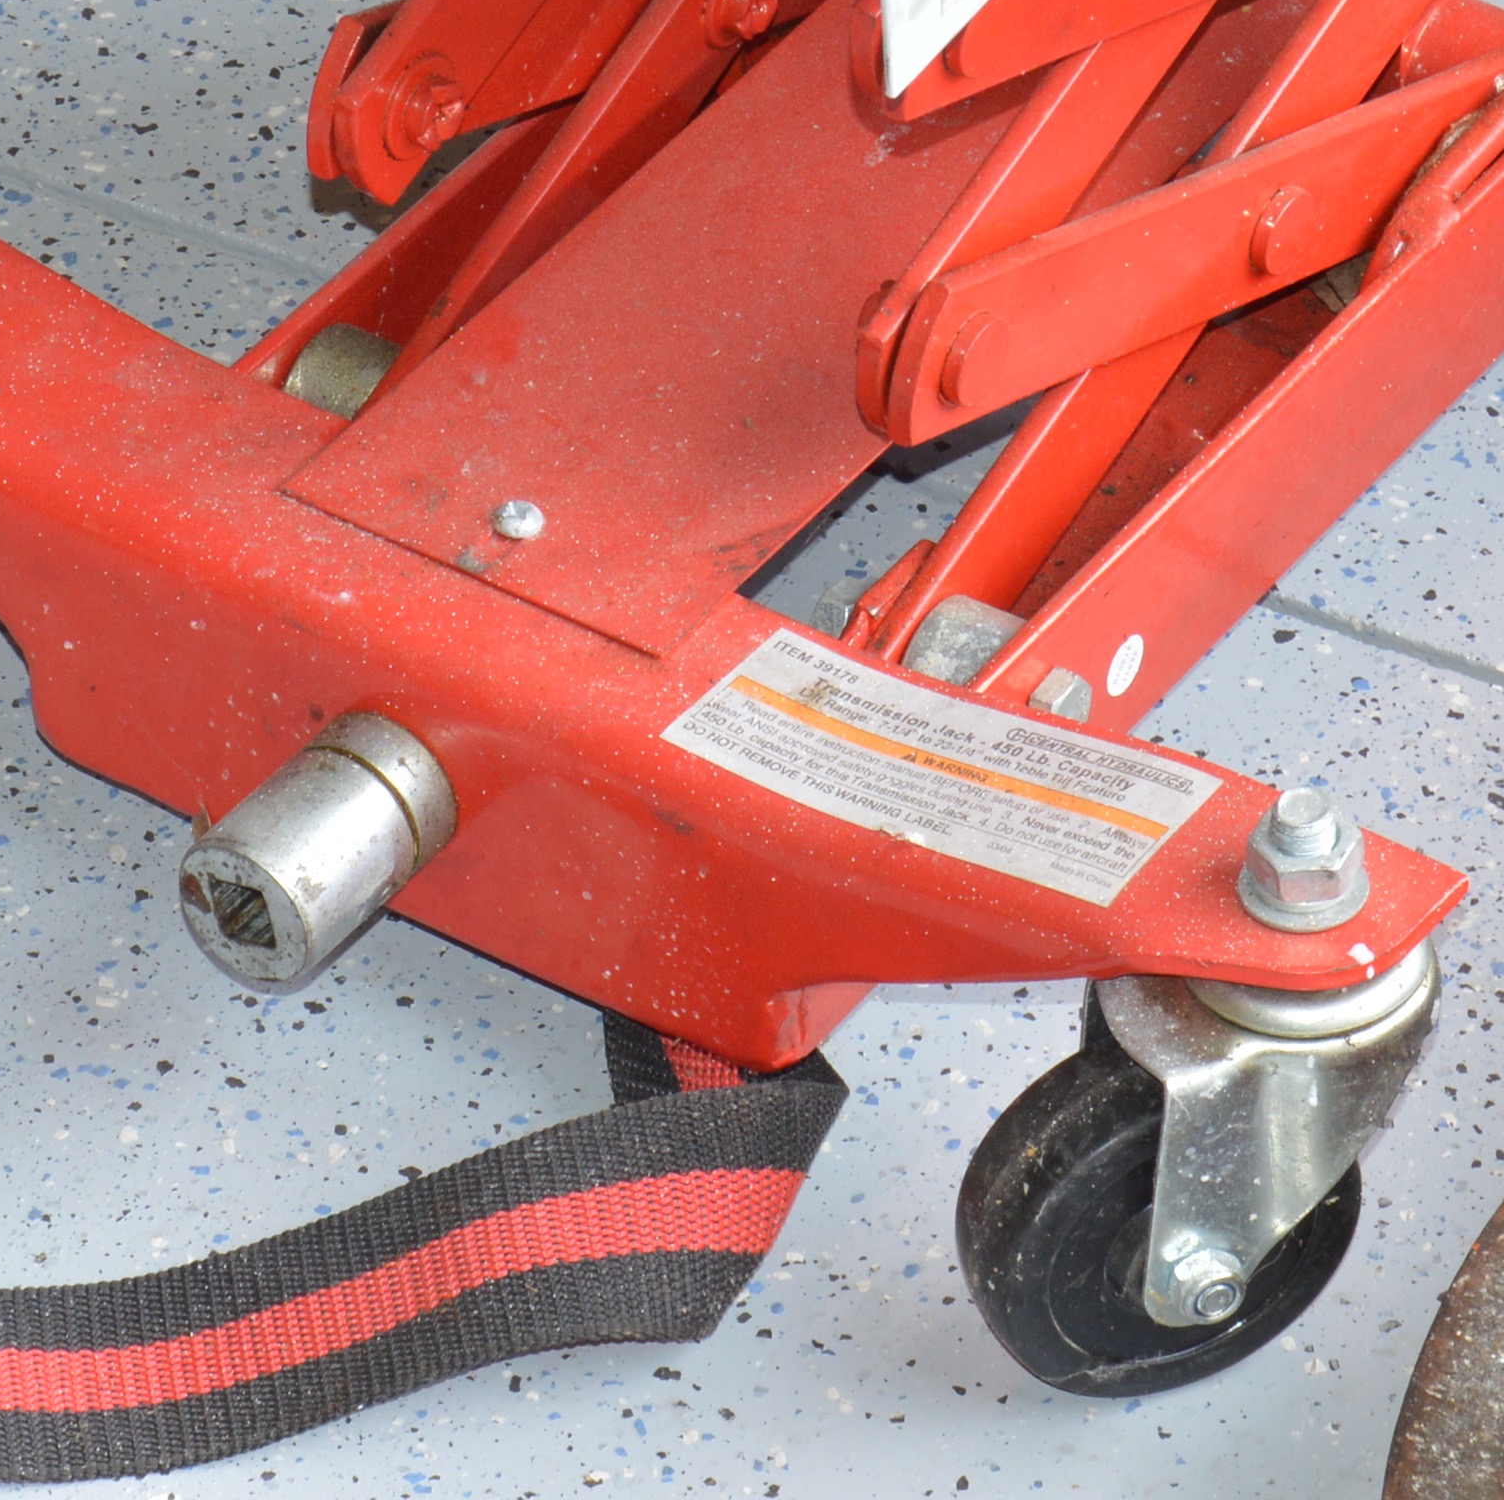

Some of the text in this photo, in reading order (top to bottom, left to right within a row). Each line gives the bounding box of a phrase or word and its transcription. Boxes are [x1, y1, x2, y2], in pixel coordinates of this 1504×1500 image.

[771, 639, 861, 684] ITEM 39178
[680, 719, 709, 736] DO
[704, 730, 742, 752] NOT
[737, 746, 803, 780] REMOVE
[799, 774, 837, 794] THIS
[831, 787, 904, 819] WARNING
[739, 699, 780, 722] Read
[775, 716, 818, 739] entire
[813, 733, 883, 765] instruction
[879, 759, 932, 781] manual
[989, 792, 1030, 812] setup
[1027, 805, 1045, 815] or
[809, 676, 933, 730] Transmission
[931, 722, 978, 743] Jack
[989, 739, 1024, 757] 450
[1023, 750, 1058, 767] Lb.
[1054, 759, 1137, 793] Capacity
[821, 697, 874, 725] Range:
[915, 733, 935, 744] to
[980, 752, 1014, 768] with
[1011, 761, 1050, 779] Table
[1048, 772, 1074, 786] Tilt
[1071, 779, 1127, 802] Feature
[920, 756, 991, 782] WARNING
[1026, 734, 1092, 760] CENTRAL
[1094, 755, 1190, 790] HYDRAULICS
[697, 709, 728, 726] 450
[746, 733, 805, 764] capacity
[802, 757, 827, 772] for
[822, 766, 852, 781] this
[848, 775, 939, 810] Transmission
[992, 821, 1017, 834] Do
[1014, 828, 1039, 842] not
[1036, 836, 1065, 850] use
[1060, 843, 1084, 856] for
[1078, 848, 1130, 872] aircraft
[741, 715, 780, 736] ANSI
[774, 732, 840, 763] approved
[836, 758, 877, 778] safety
[873, 771, 928, 795] goggles
[925, 787, 970, 808] during
[1020, 815, 1062, 835] Never
[1060, 828, 1111, 851] exceed
[1111, 846, 1138, 860] the
[1072, 869, 1086, 878] in
